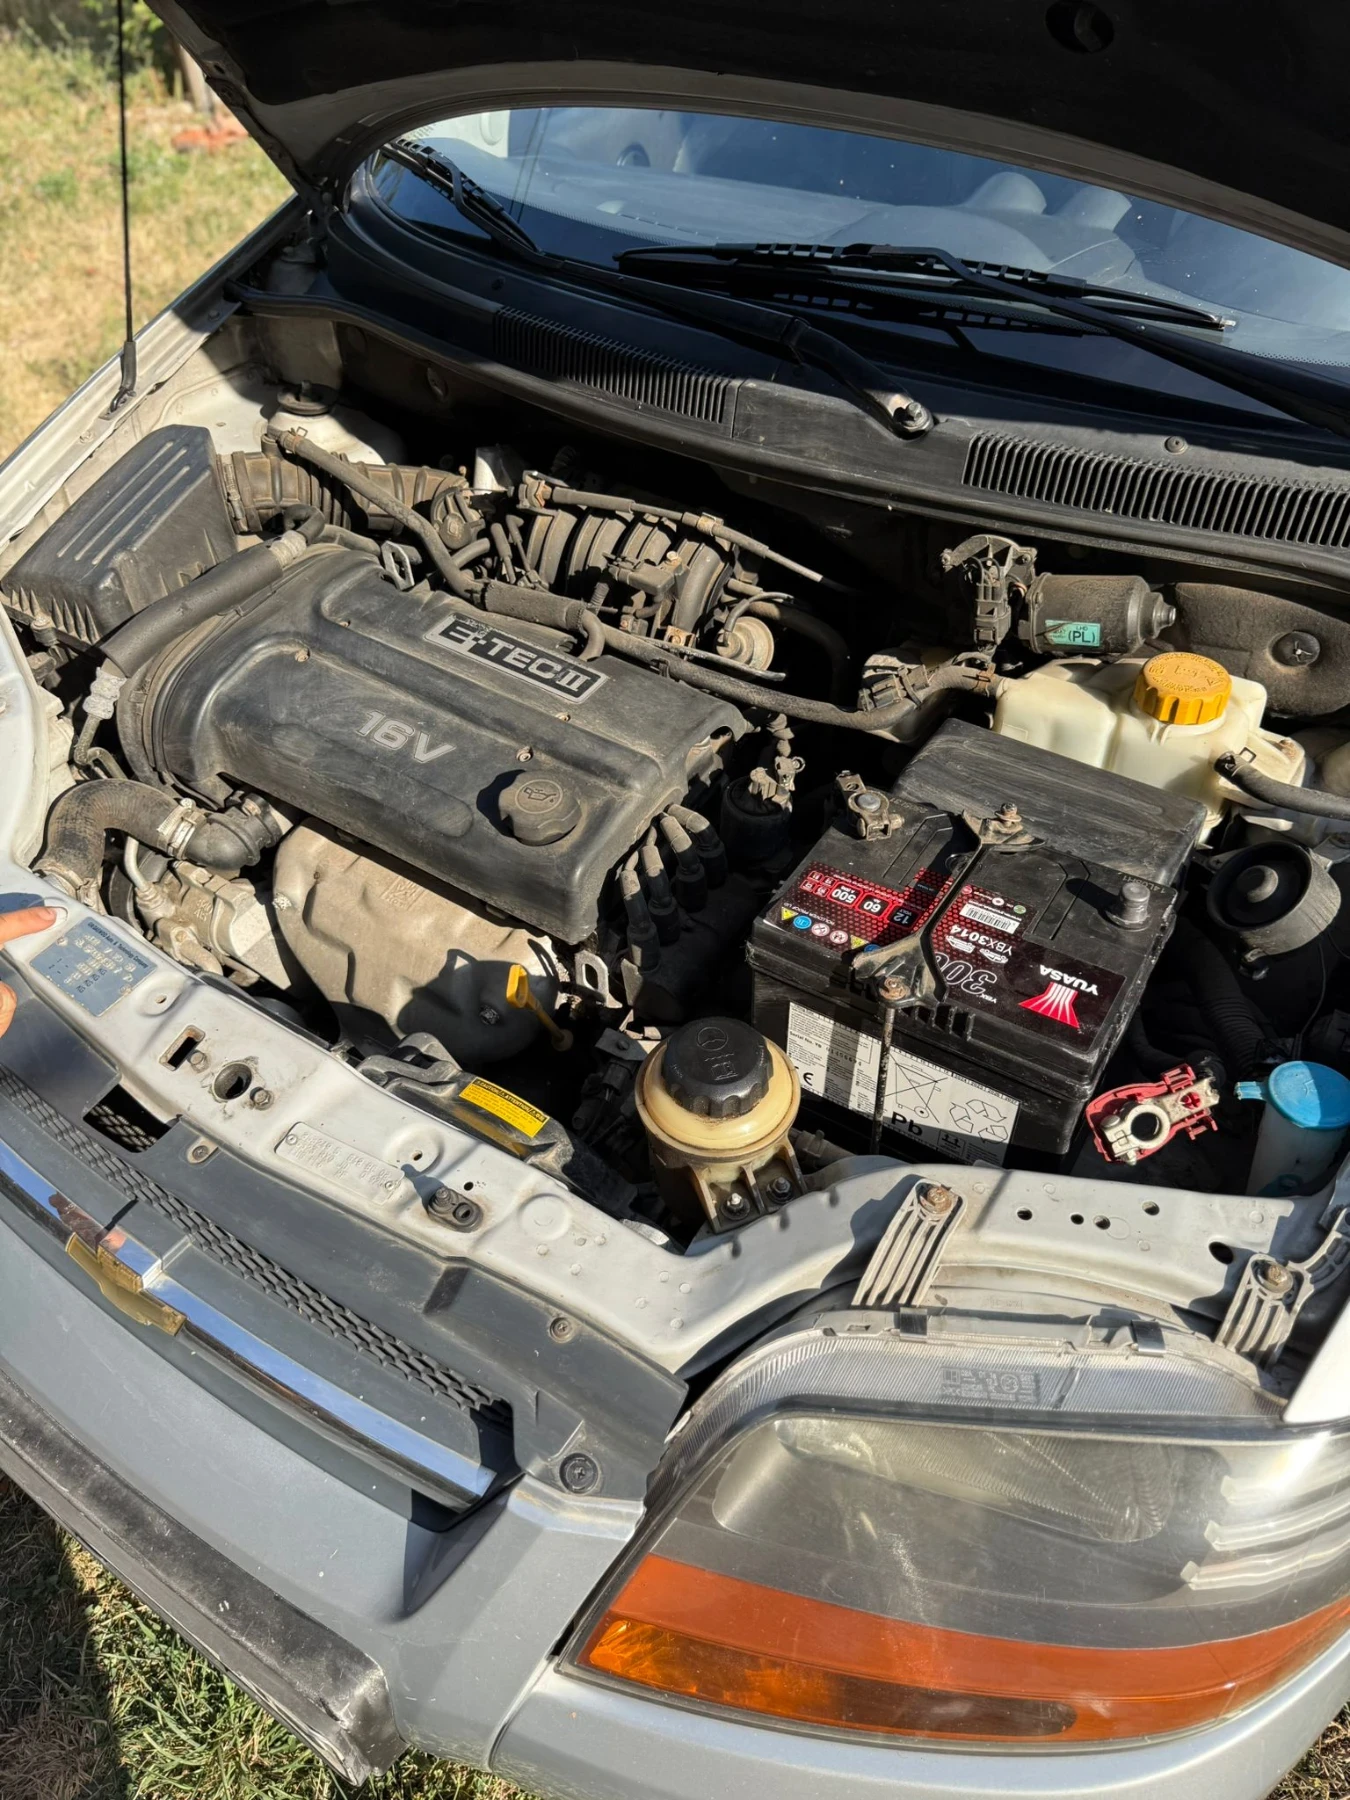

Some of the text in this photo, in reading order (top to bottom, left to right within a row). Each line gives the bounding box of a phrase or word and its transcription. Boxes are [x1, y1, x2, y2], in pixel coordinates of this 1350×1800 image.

[1068, 630, 1096, 644] (PL)
[356, 710, 456, 763] 16V
[832, 888, 856, 905] 500
[863, 900, 881, 913] 60
[899, 908, 912, 916] VOLT
[893, 912, 910, 925] 12
[949, 924, 1012, 956] YBX3014
[1040, 964, 1098, 996] YUASA
[890, 1111, 924, 1136] Pb
